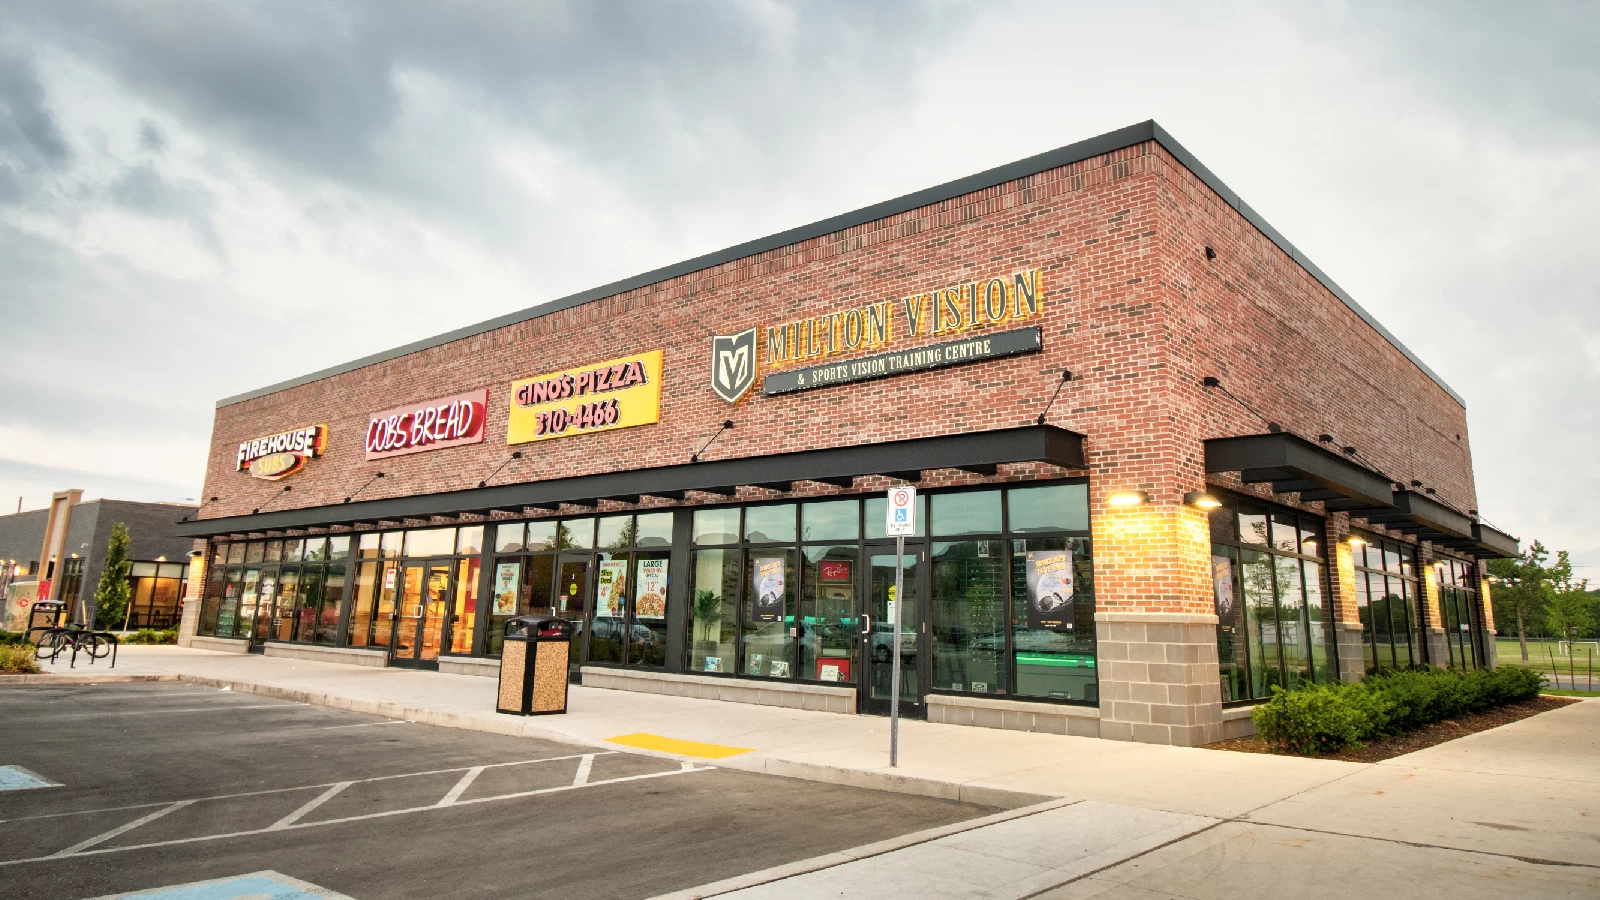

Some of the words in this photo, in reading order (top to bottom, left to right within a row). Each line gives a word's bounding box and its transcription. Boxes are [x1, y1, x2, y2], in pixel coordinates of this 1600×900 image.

[765, 303, 887, 364] MILTON
[903, 269, 1037, 336] VISION
[515, 373, 575, 407] GINO'S
[574, 360, 648, 396] PIZZA
[797, 373, 805, 385] &
[812, 365, 848, 383] SPORTS
[851, 358, 885, 376] VISION
[888, 347, 942, 371] TRAINING
[945, 339, 991, 360] CENTRE
[365, 413, 409, 452] COBS
[410, 400, 473, 444] BREAD
[534, 398, 620, 437] 310-4466
[235, 426, 317, 472] FIREHOUSE
[257, 455, 286, 474] SUBS
[643, 560, 663, 568] LARGE
